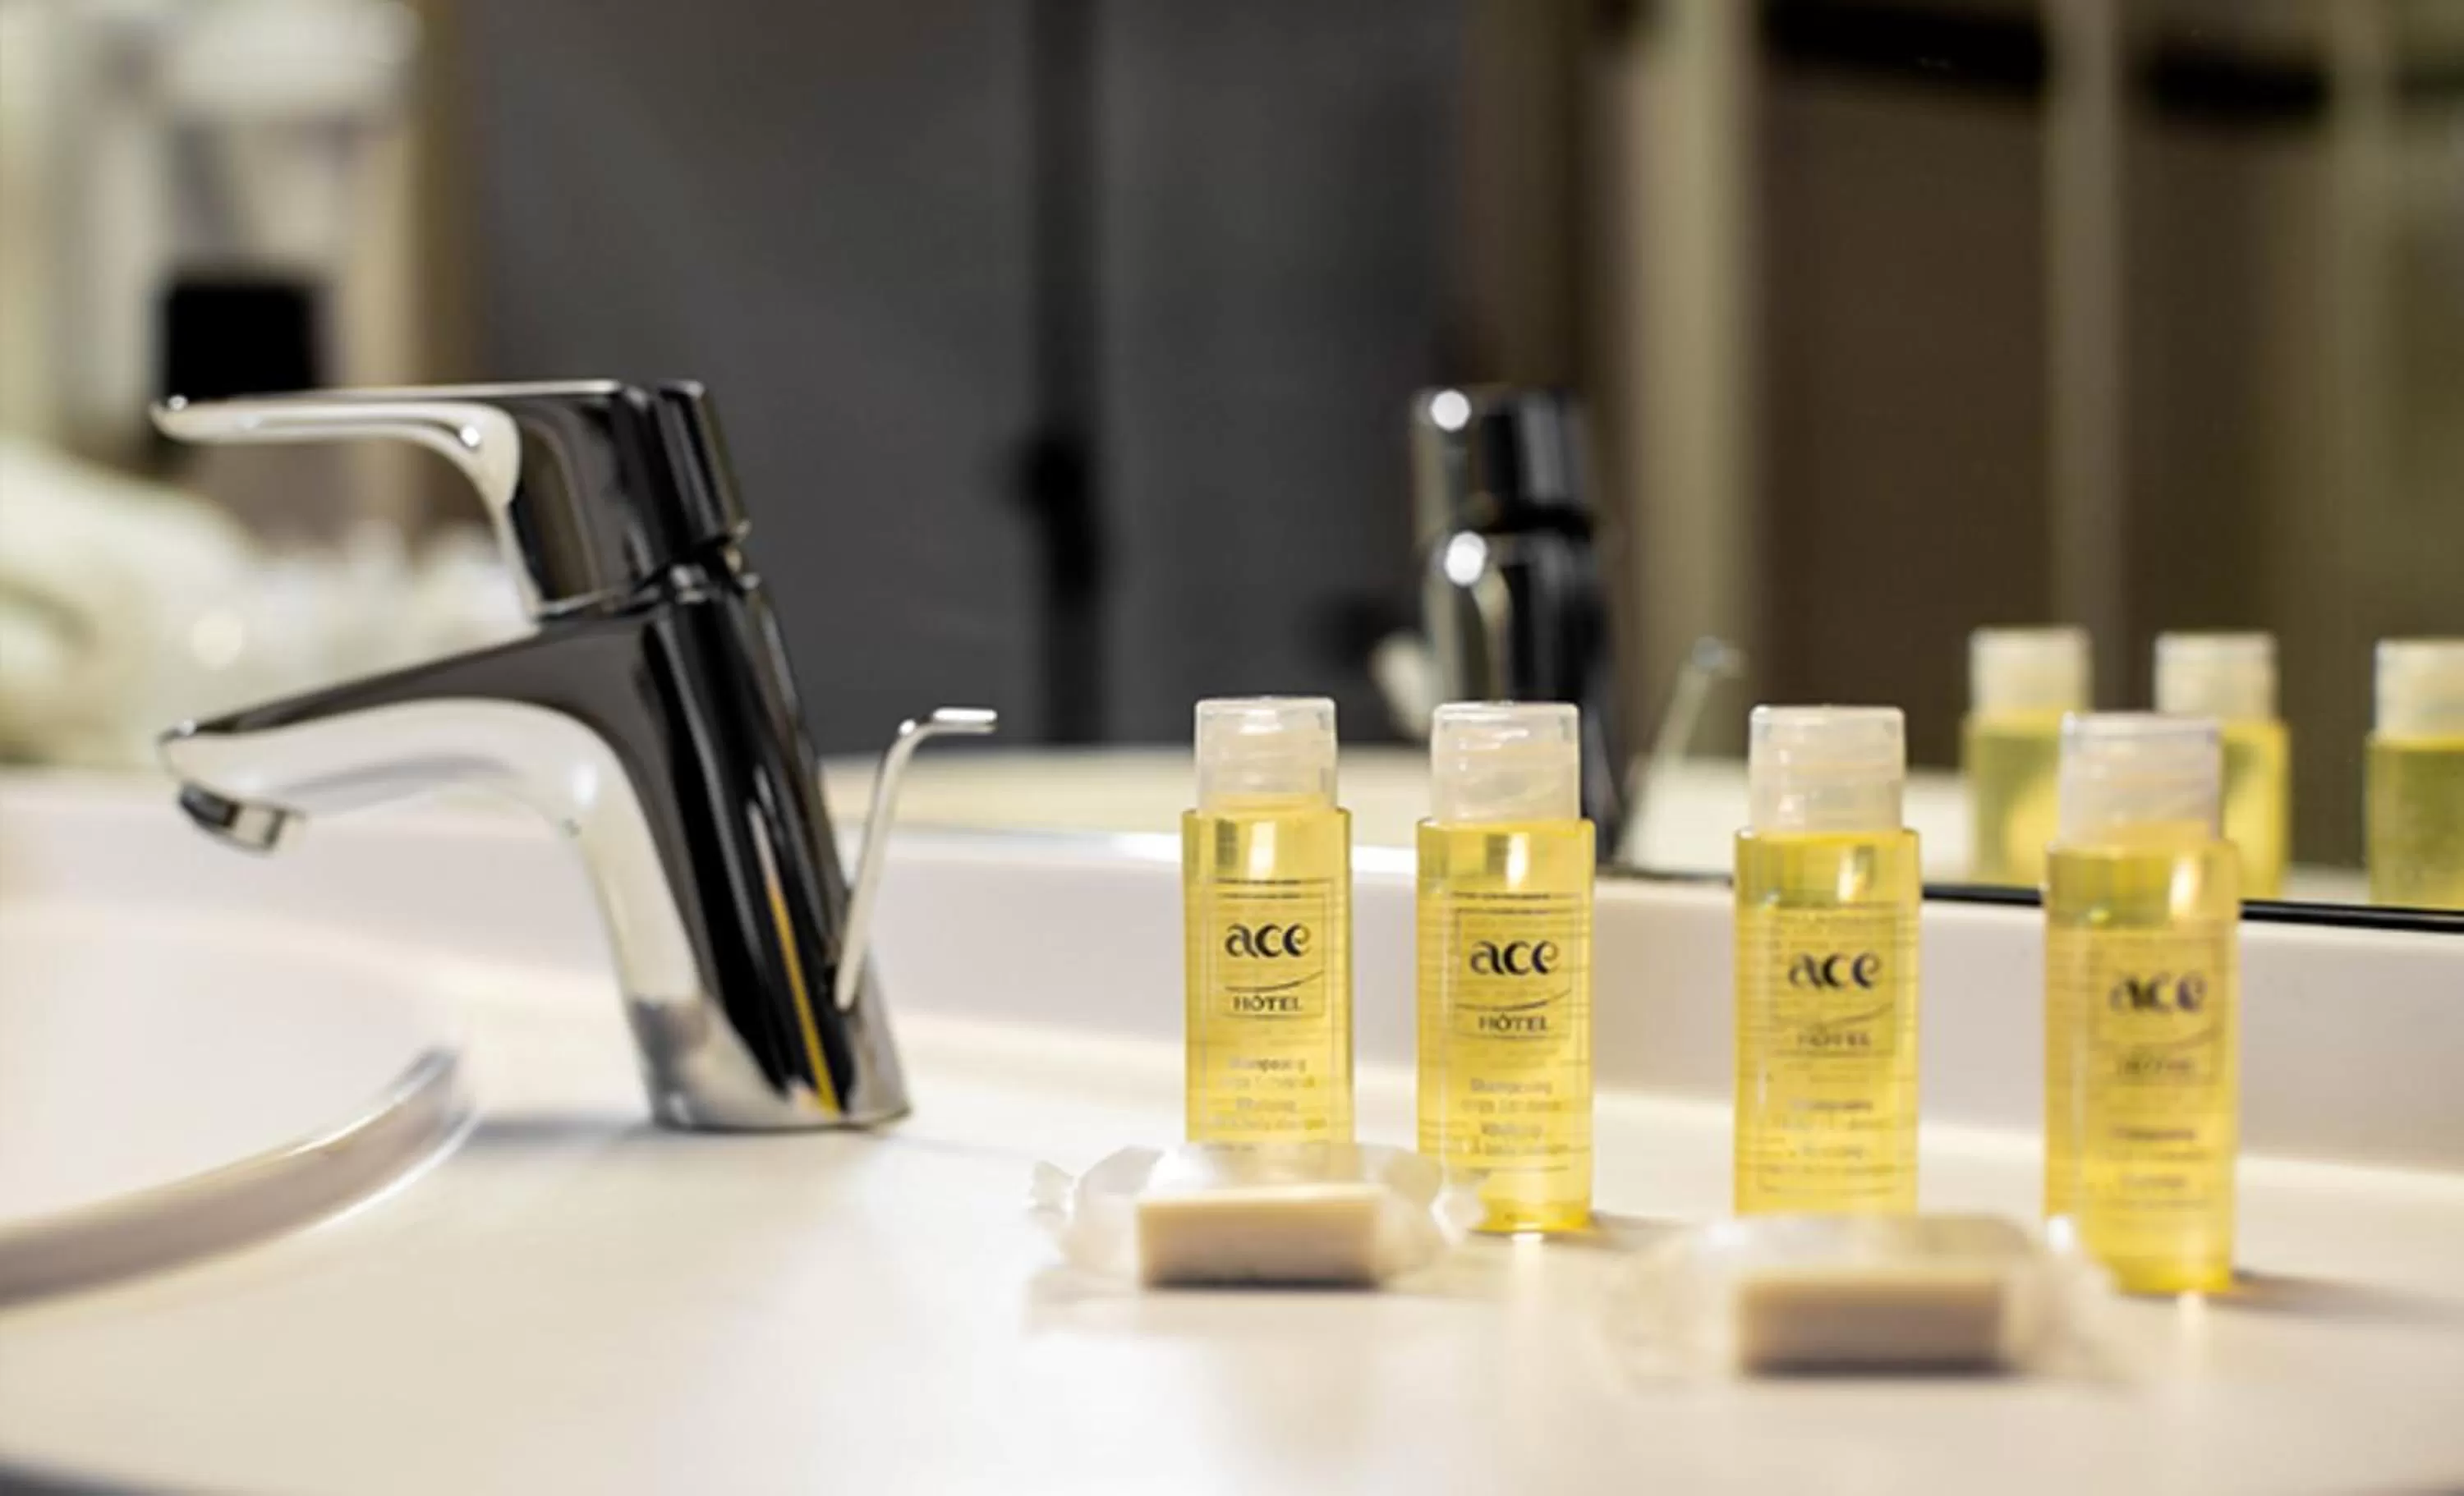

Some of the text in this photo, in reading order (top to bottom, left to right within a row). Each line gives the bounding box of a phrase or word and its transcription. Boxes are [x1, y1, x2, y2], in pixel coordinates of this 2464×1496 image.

[1224, 923, 1312, 958] ace
[1469, 940, 1560, 975] ace
[1788, 950, 1883, 990] ace
[1233, 994, 1303, 1012] HÔTEL
[2108, 971, 2209, 1015] ace
[1478, 1012, 1548, 1032] HÔTEL
